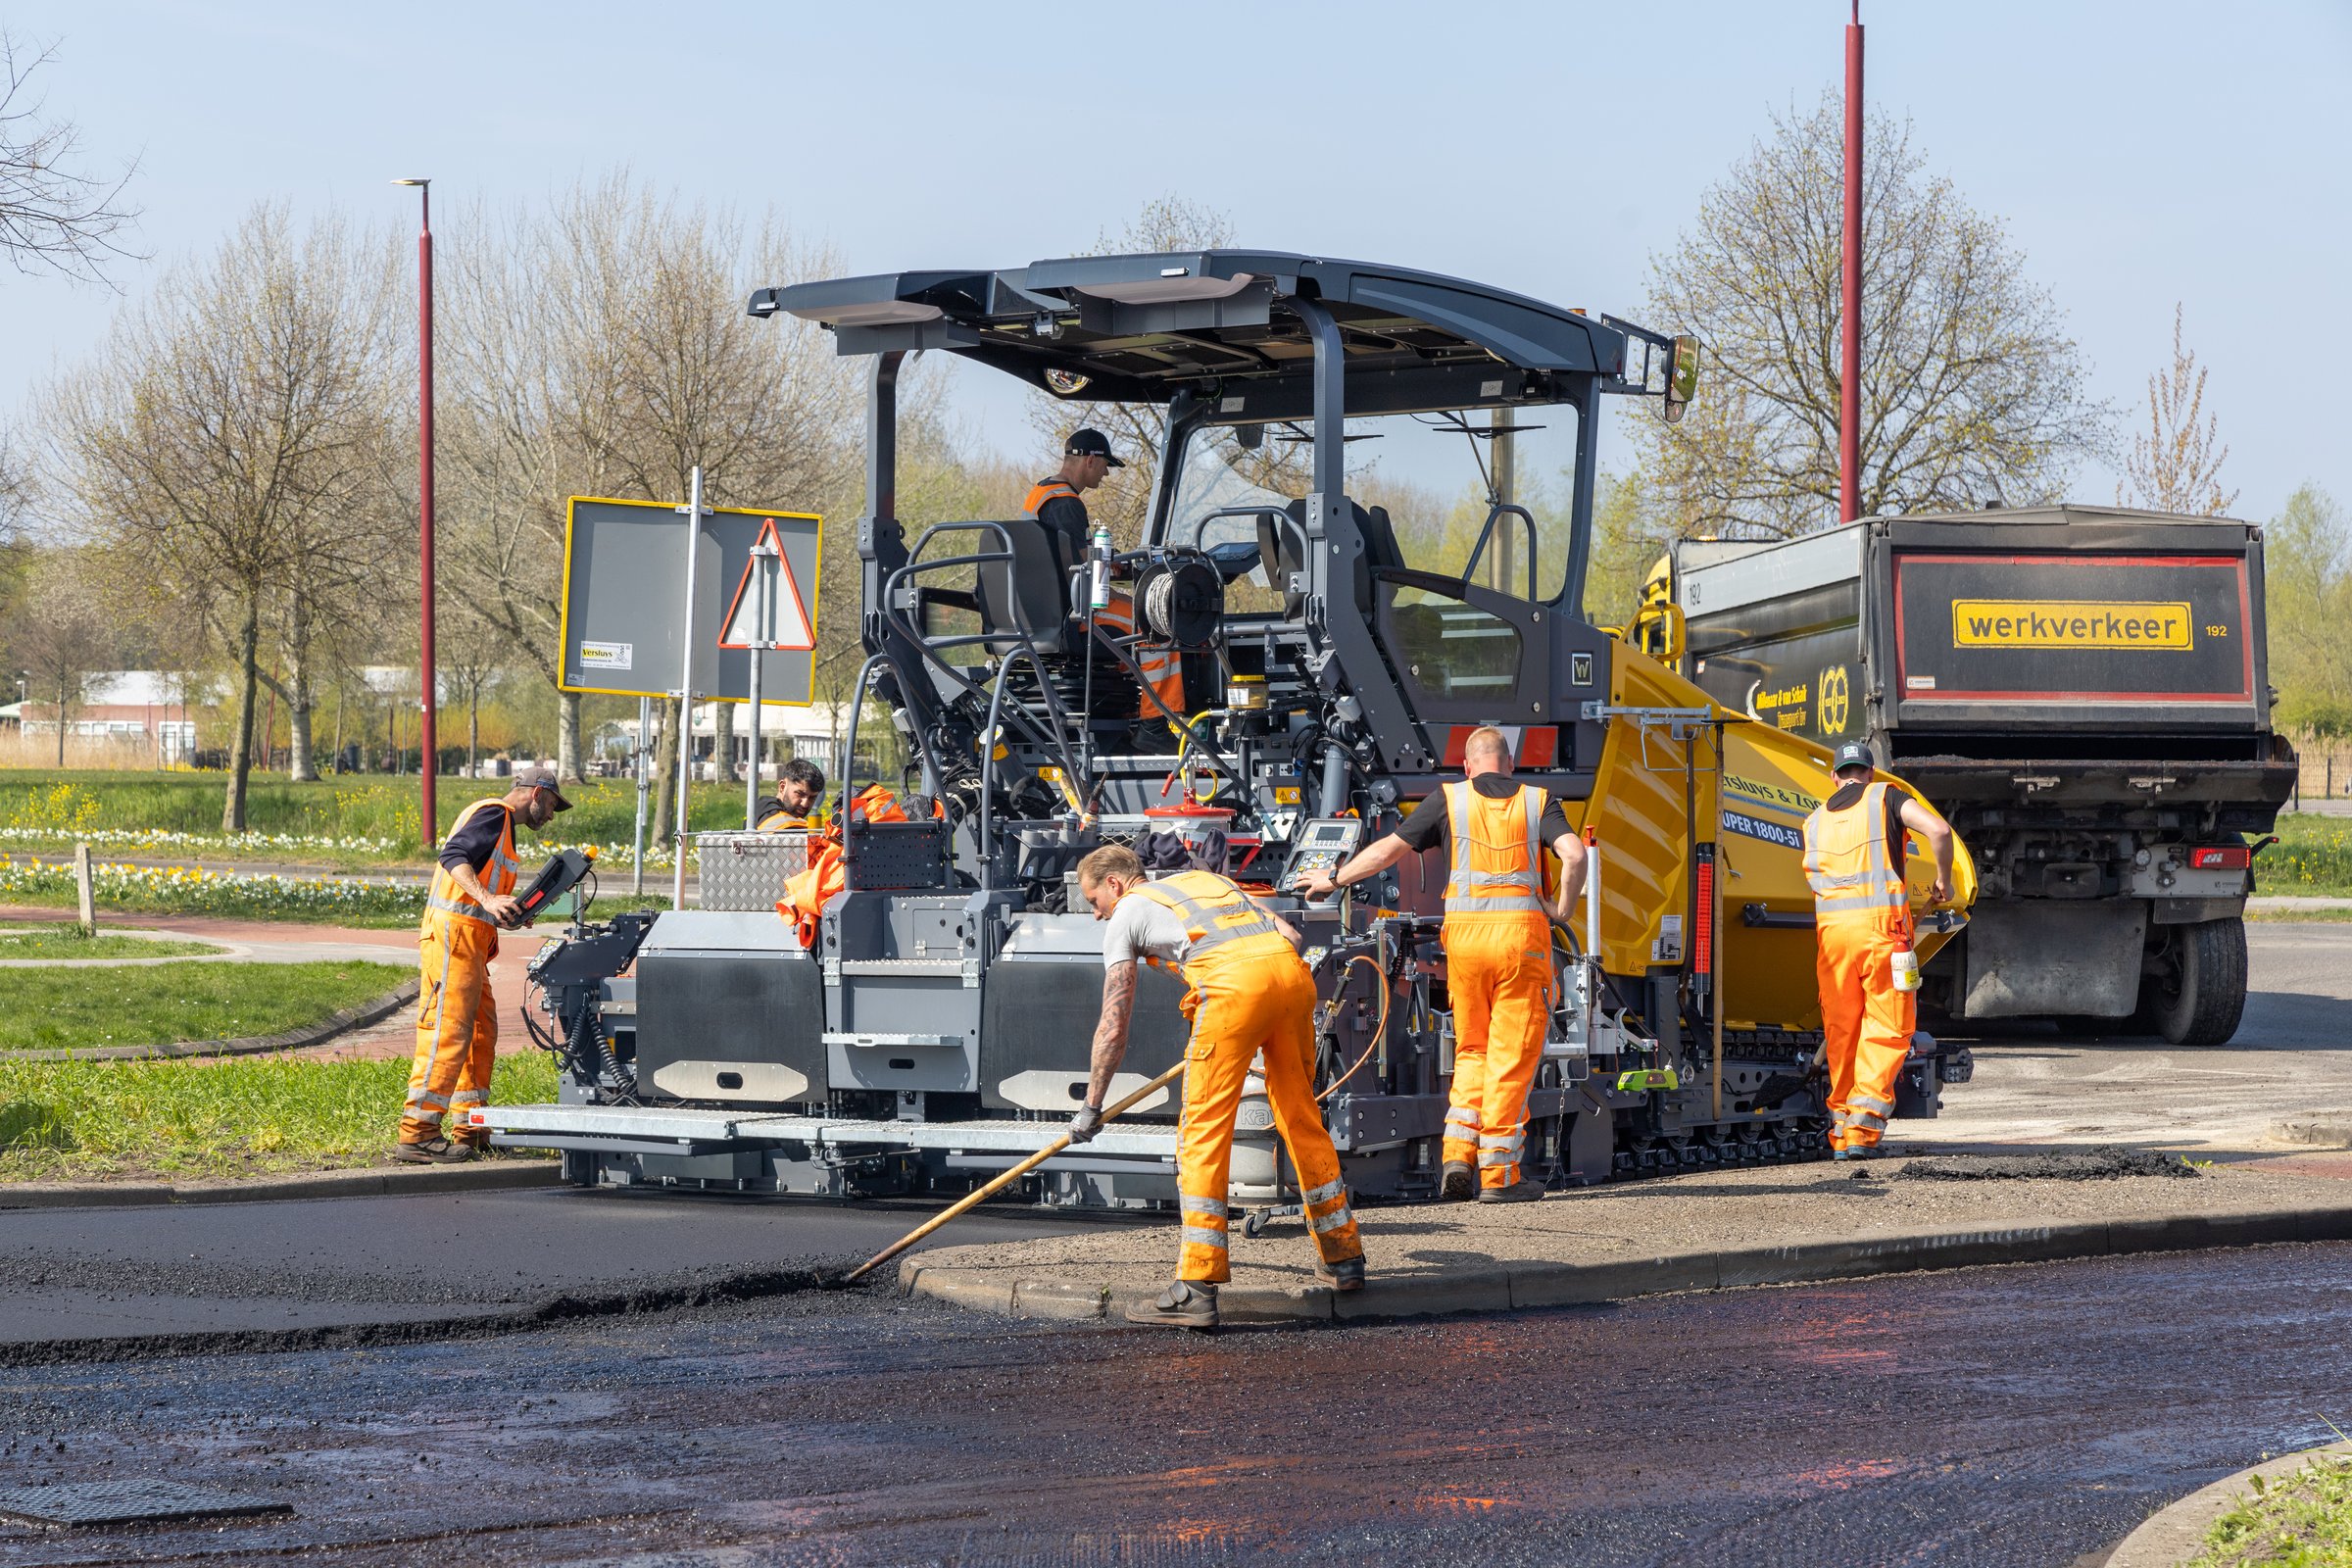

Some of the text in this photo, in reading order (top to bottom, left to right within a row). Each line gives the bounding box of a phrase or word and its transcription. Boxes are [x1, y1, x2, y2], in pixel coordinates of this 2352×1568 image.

[1690, 582, 1701, 607] 192
[1968, 611, 2177, 640] werkverkeer
[2205, 625, 2228, 637] 192
[582, 648, 613, 659] Versluys
[798, 740, 831, 760] SMAAK
[1723, 775, 1775, 800] rsluys
[1777, 789, 1791, 804] &
[1790, 792, 1822, 810] Zoo
[1723, 812, 1800, 848] UPER 1800-5i
[1241, 1102, 1274, 1126] ka
